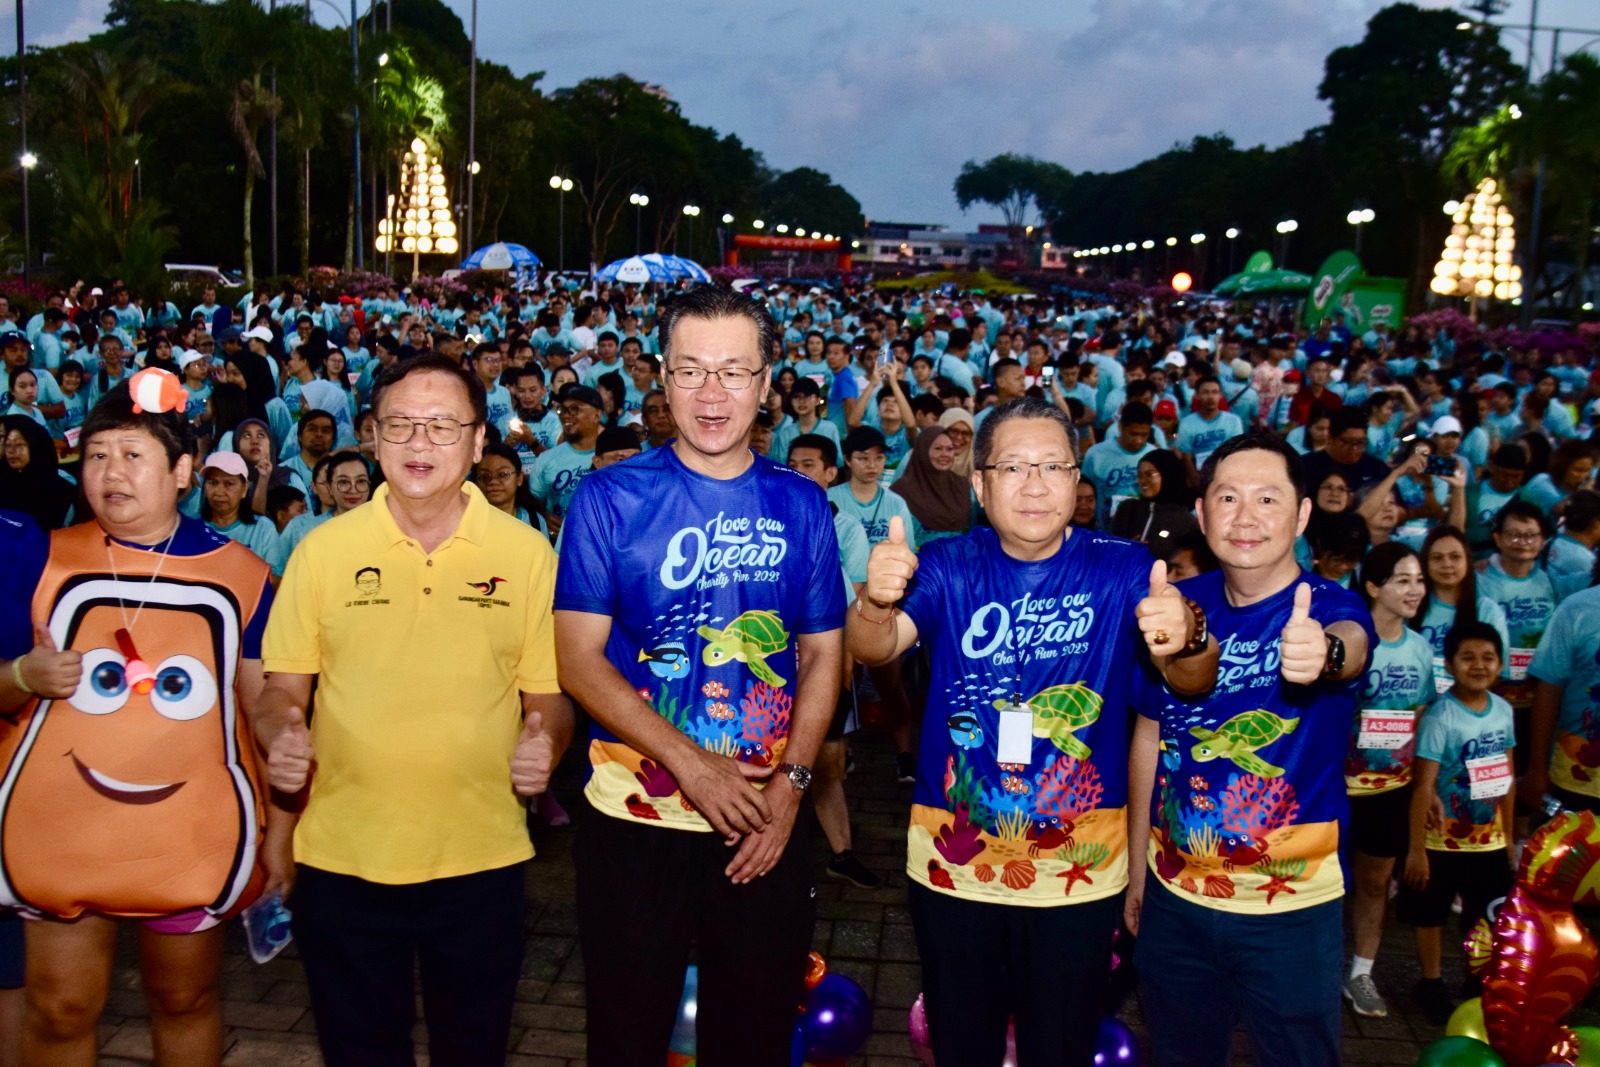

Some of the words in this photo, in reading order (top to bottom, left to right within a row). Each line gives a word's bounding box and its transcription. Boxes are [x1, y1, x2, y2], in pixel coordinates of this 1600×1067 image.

[705, 511, 753, 544] Love
[755, 517, 785, 532] our
[660, 527, 787, 590] Ocean
[696, 572, 730, 591] Charity
[753, 570, 780, 583] 2023
[1011, 592, 1060, 623] Love
[961, 602, 1094, 659] Ocean
[1034, 647, 1058, 660] Run
[1061, 642, 1090, 657] 2023
[1218, 633, 1260, 665] Love
[1368, 721, 1411, 732] A3-0086
